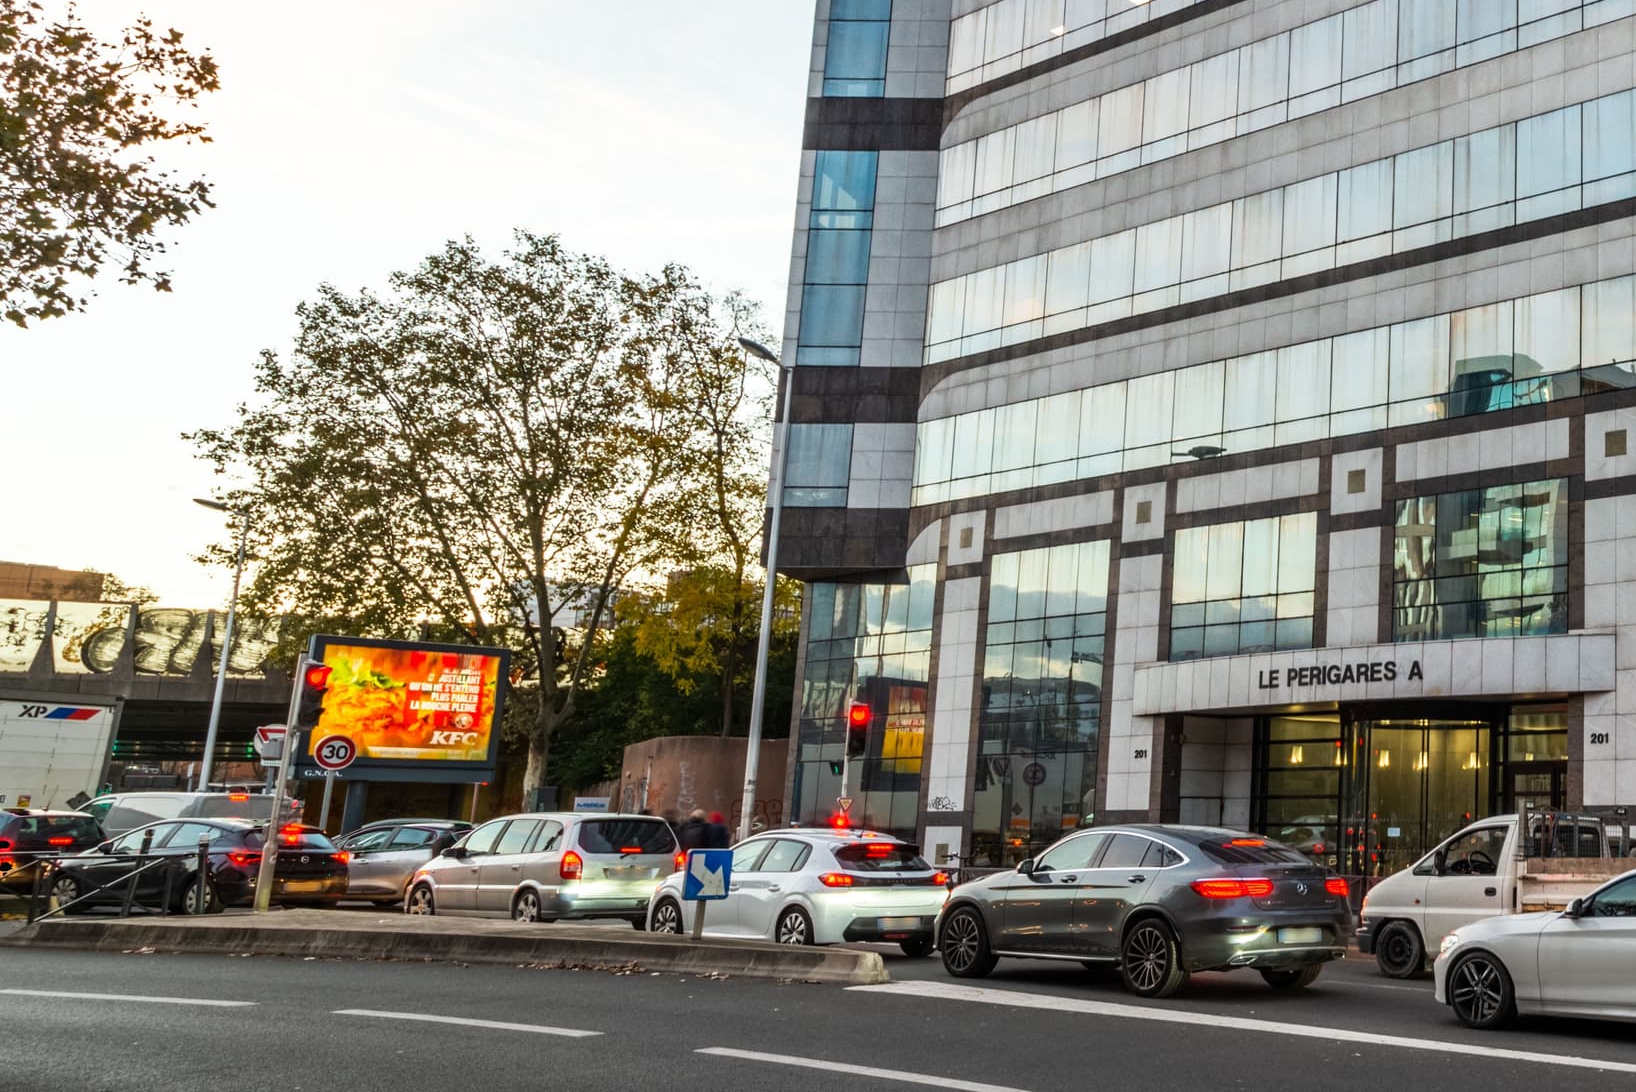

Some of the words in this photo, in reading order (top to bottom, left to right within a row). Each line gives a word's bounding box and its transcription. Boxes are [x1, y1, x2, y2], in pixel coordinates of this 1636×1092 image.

[1259, 670, 1279, 689] LE
[1287, 661, 1397, 687] PERIGARES
[1407, 660, 1423, 681] A
[431, 692, 450, 701] PLUS
[451, 693, 478, 703] PARLER
[410, 700, 420, 710] LA
[451, 703, 477, 713] PLEINE
[429, 730, 478, 745] KFC
[1590, 732, 1609, 744] 201
[324, 744, 349, 759] 30
[1134, 749, 1147, 759] 201
